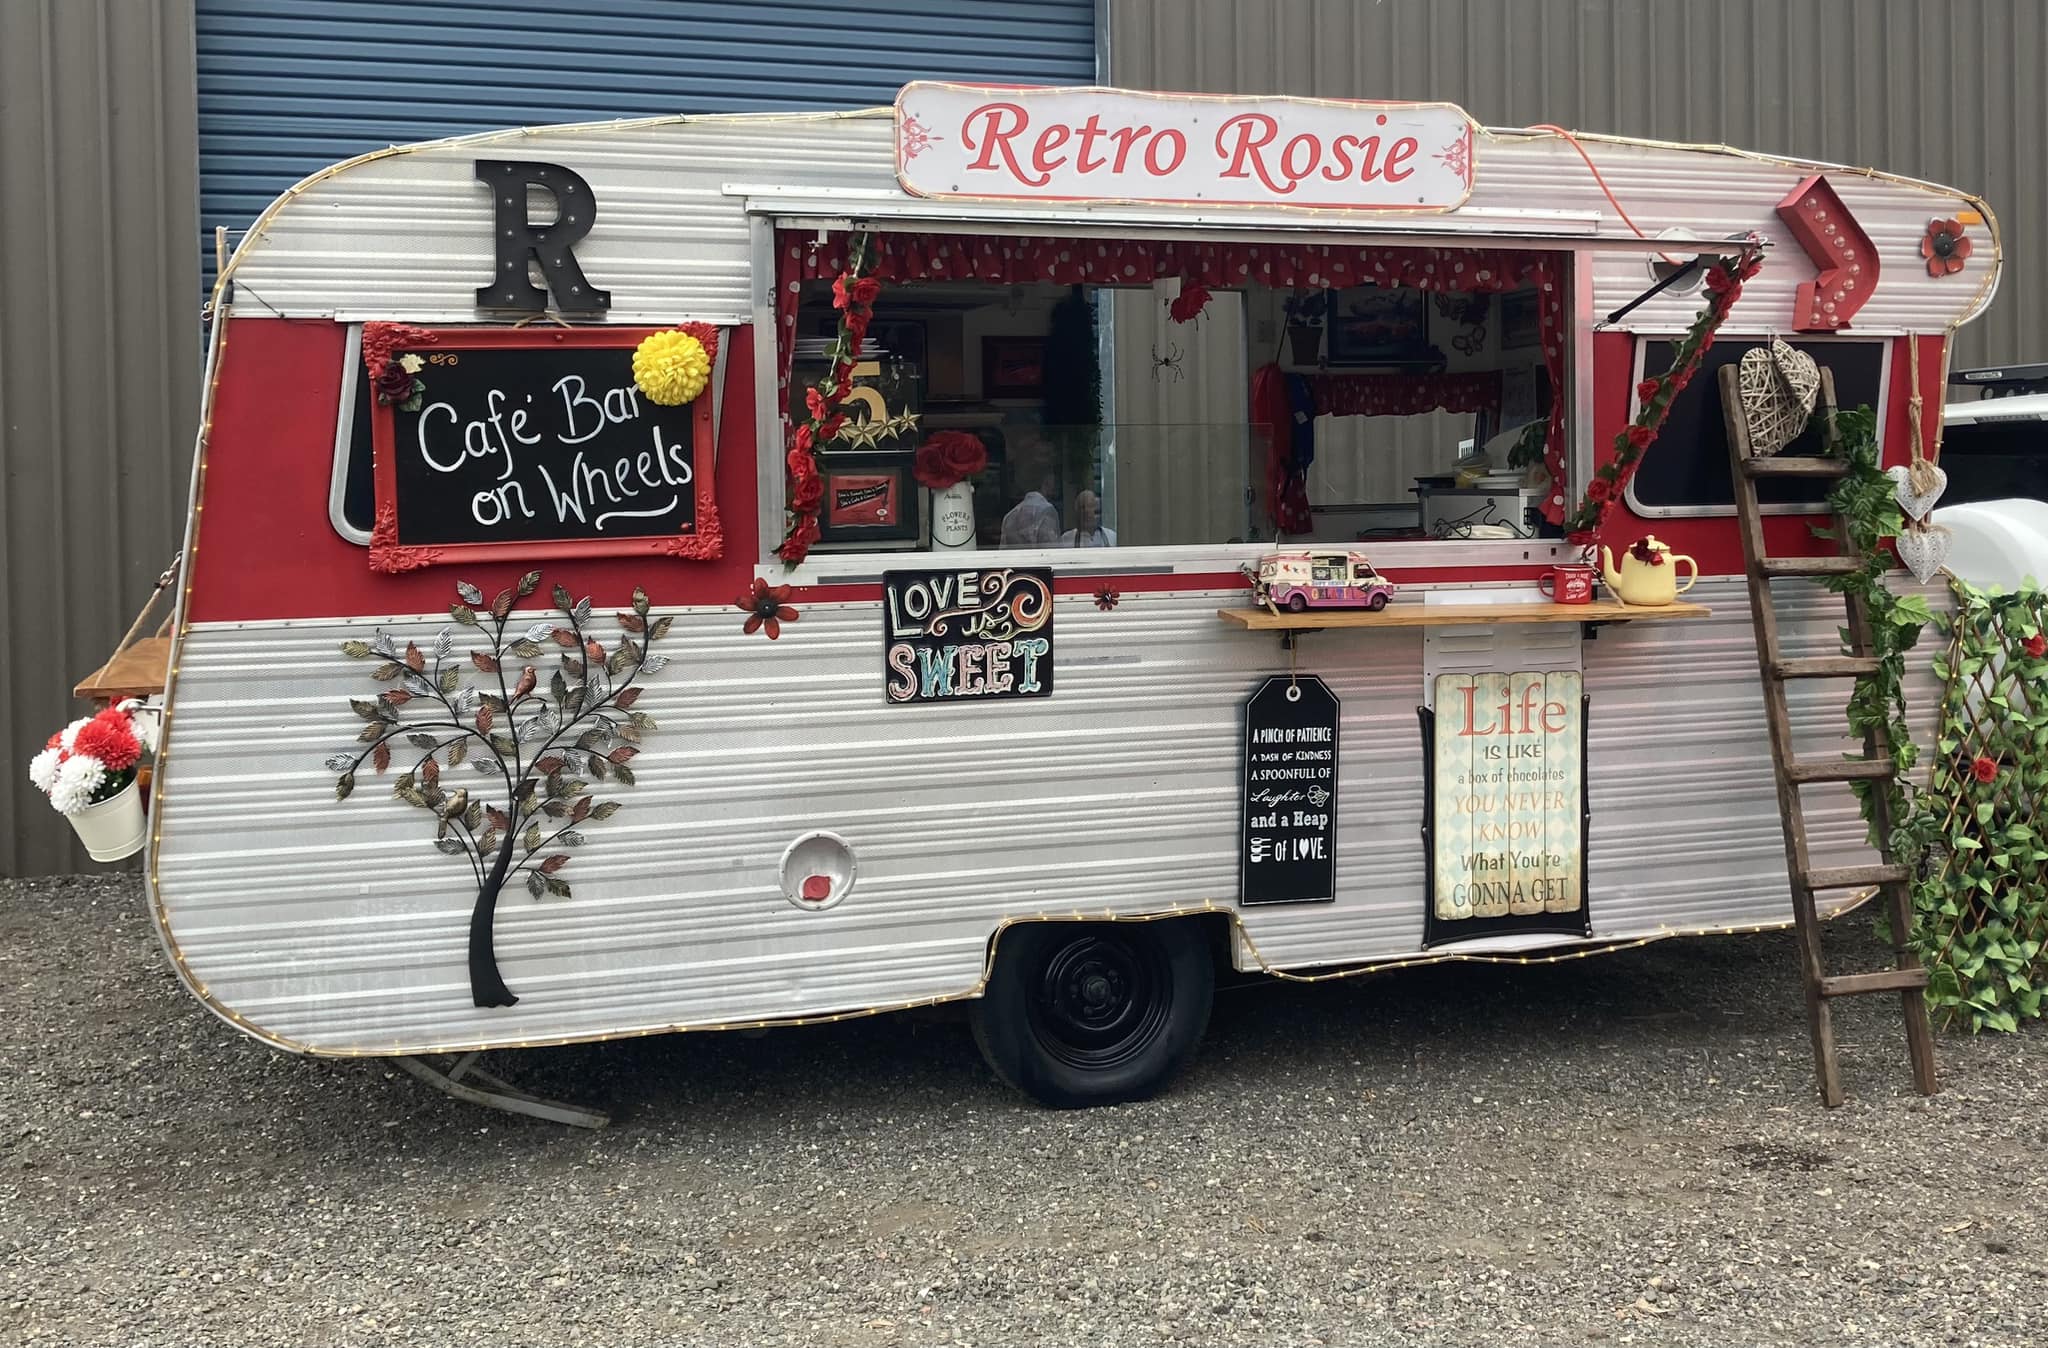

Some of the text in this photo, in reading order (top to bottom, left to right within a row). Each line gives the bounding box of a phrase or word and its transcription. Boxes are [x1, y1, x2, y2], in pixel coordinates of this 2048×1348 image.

[961, 102, 1419, 195] Retro Rosie
[474, 159, 612, 313] R
[418, 375, 640, 481] Café Bar
[472, 425, 693, 525] on Wheels
[942, 511, 970, 522] FLOWERS
[945, 524, 968, 532] PLANTS
[887, 571, 982, 640] LOVE
[887, 637, 1050, 702] SWEET
[1456, 681, 1567, 736] Life
[1252, 726, 1332, 743] A PINCH OF PATIENCE
[1251, 749, 1332, 762] A DASH OF KINDNESS
[1484, 744, 1501, 760] IS
[1251, 767, 1332, 780] A SPOONFULL OF
[1457, 767, 1565, 785] a box of chocolates
[1455, 790, 1565, 815] YOU NEVER
[1250, 810, 1329, 831] and a Heap
[1479, 820, 1541, 842] KNOW
[1460, 852, 1505, 872] What
[1453, 877, 1569, 908] GONNA GET
